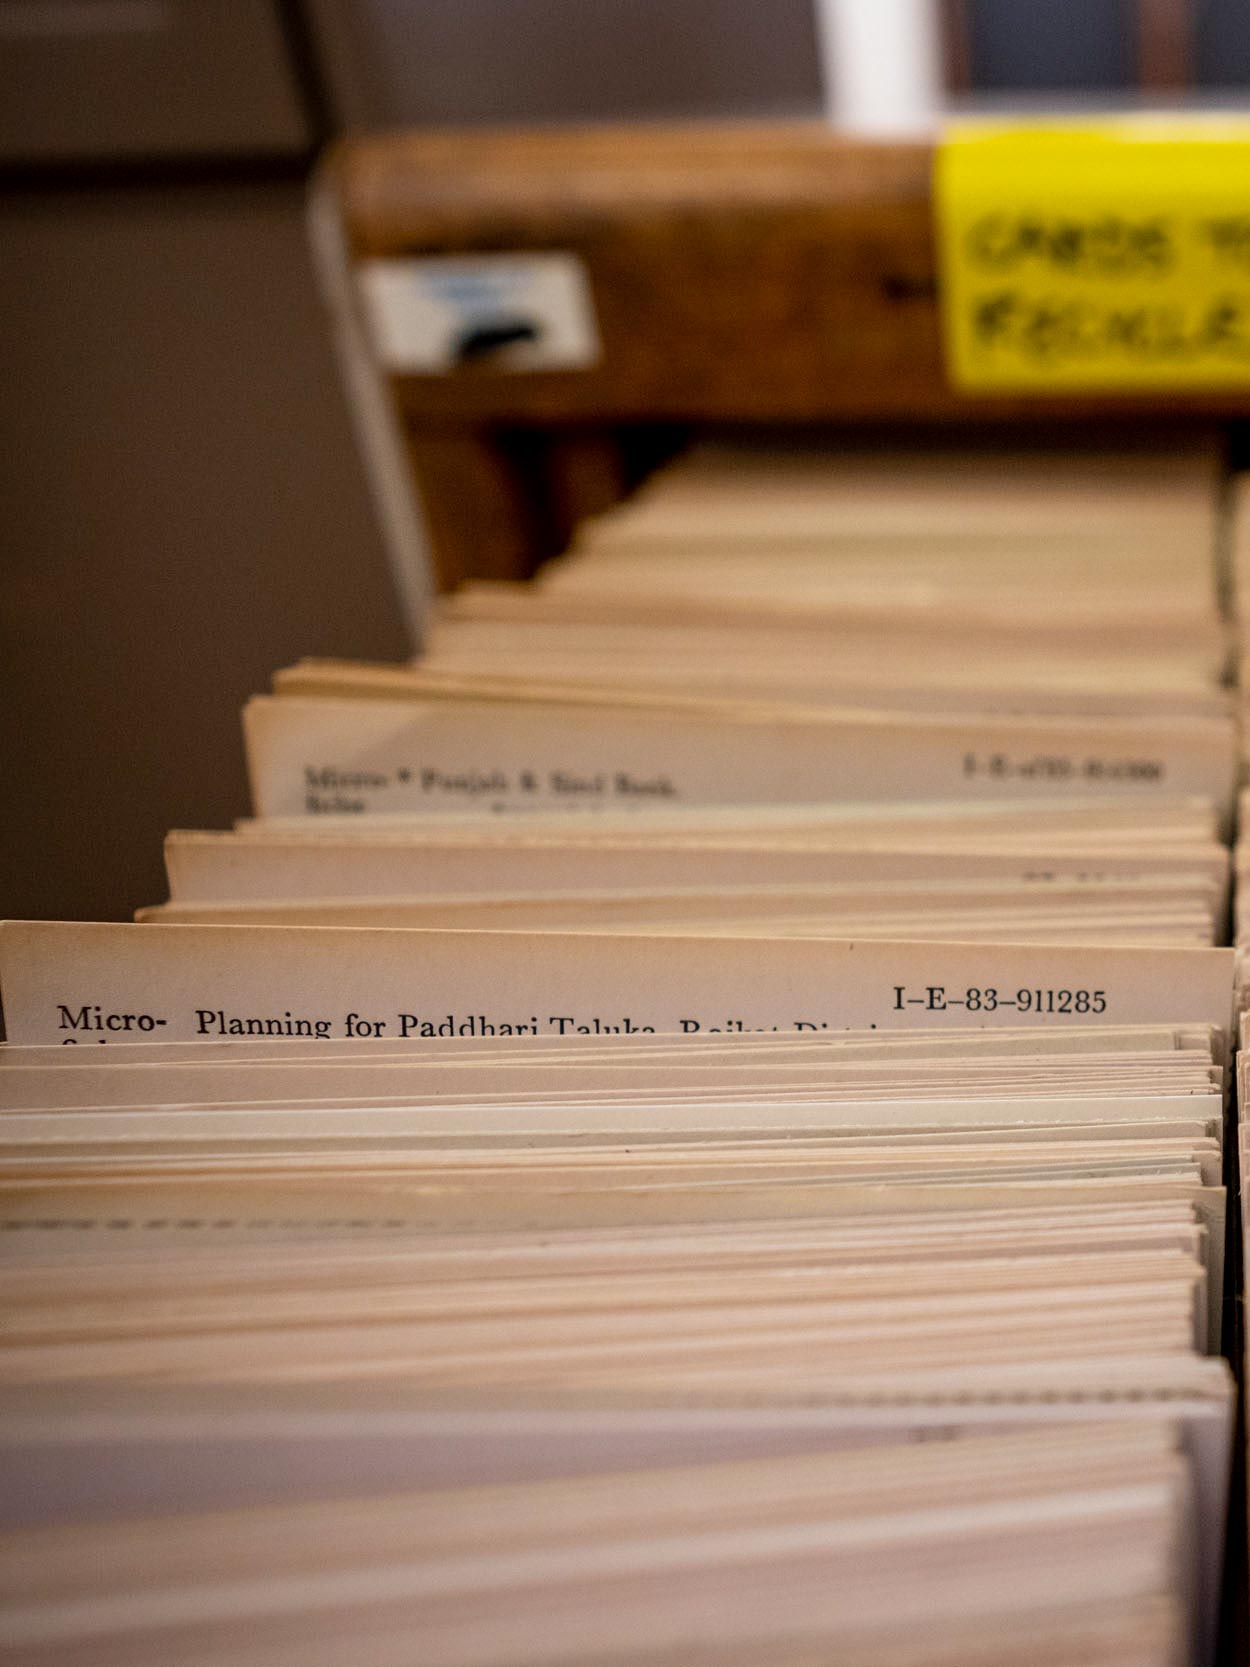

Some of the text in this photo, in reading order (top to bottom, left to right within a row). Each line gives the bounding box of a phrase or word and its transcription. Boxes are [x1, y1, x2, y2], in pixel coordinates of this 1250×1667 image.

[57, 1005, 167, 1031] Micro-
[195, 1010, 333, 1039] Planning
[345, 1013, 387, 1038] for
[397, 1014, 538, 1038] Paddhari
